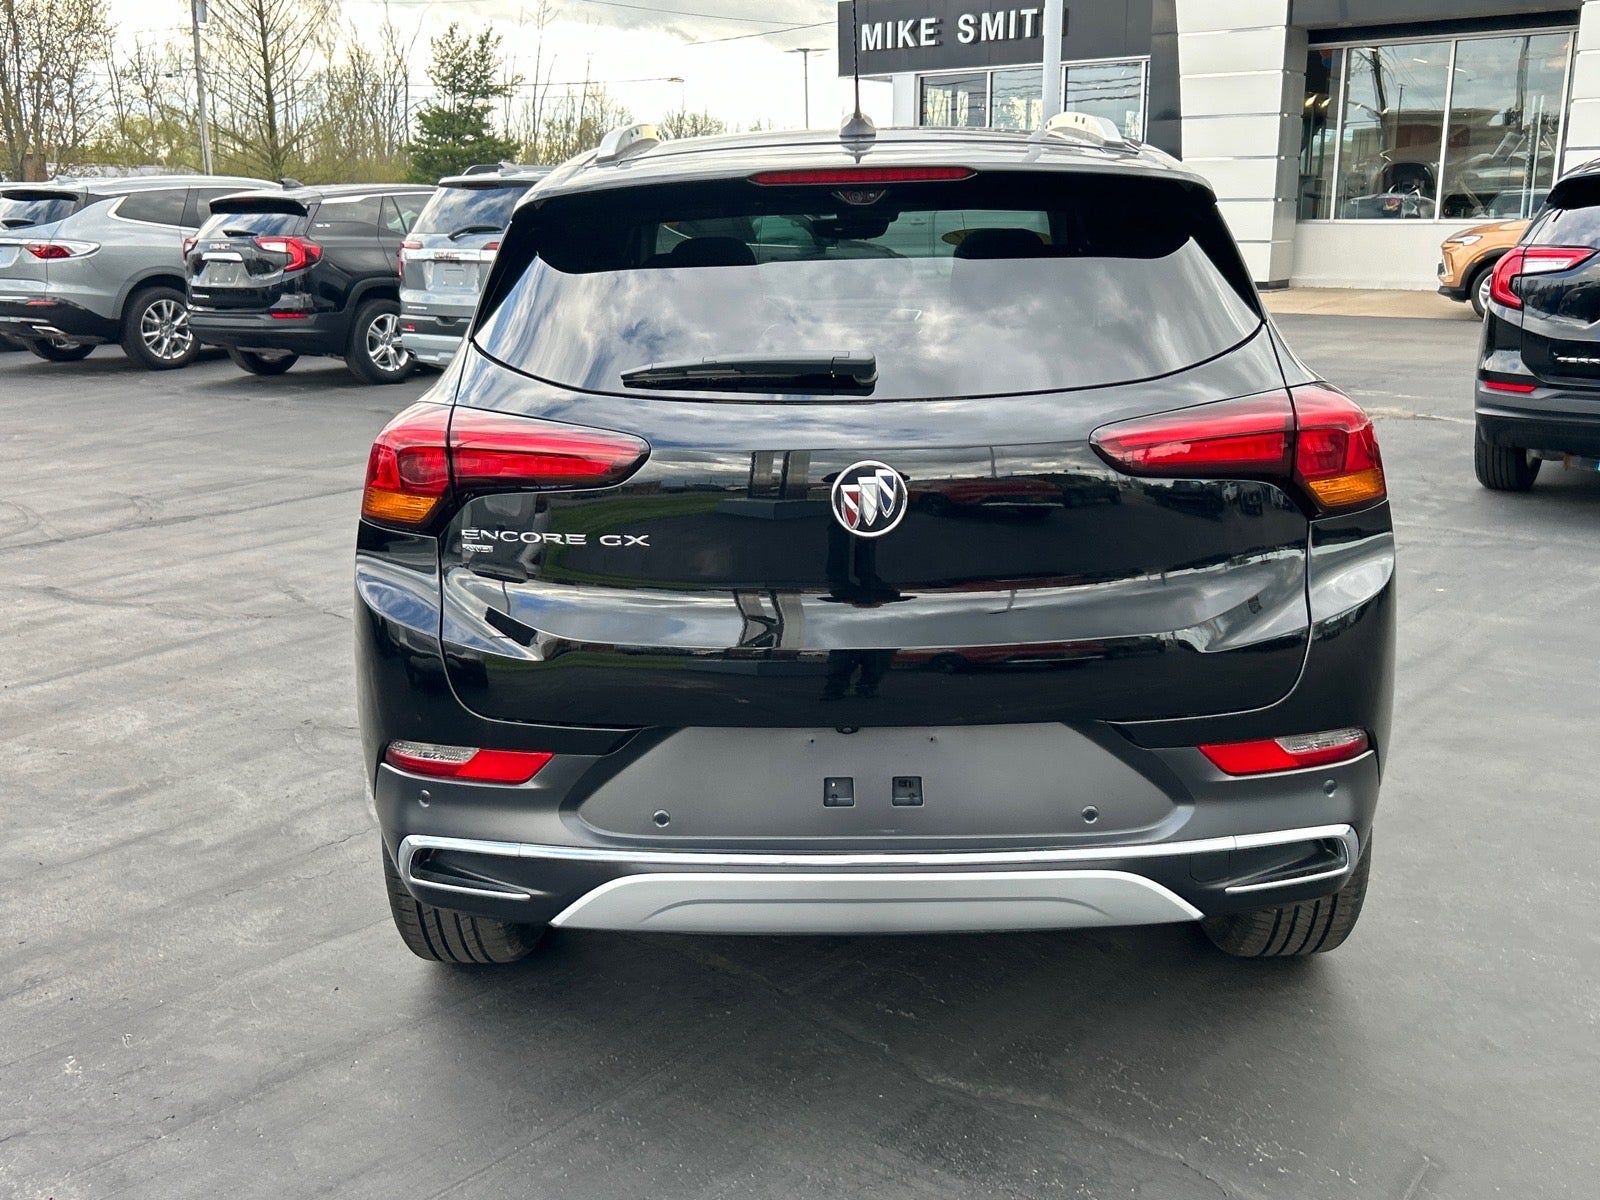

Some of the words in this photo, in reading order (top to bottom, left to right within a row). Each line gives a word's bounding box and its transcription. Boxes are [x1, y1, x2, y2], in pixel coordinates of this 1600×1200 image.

[861, 17, 937, 51] MIKE
[957, 8, 1046, 44] SMIT
[461, 529, 586, 545] ENCORE
[599, 534, 650, 546] GX
